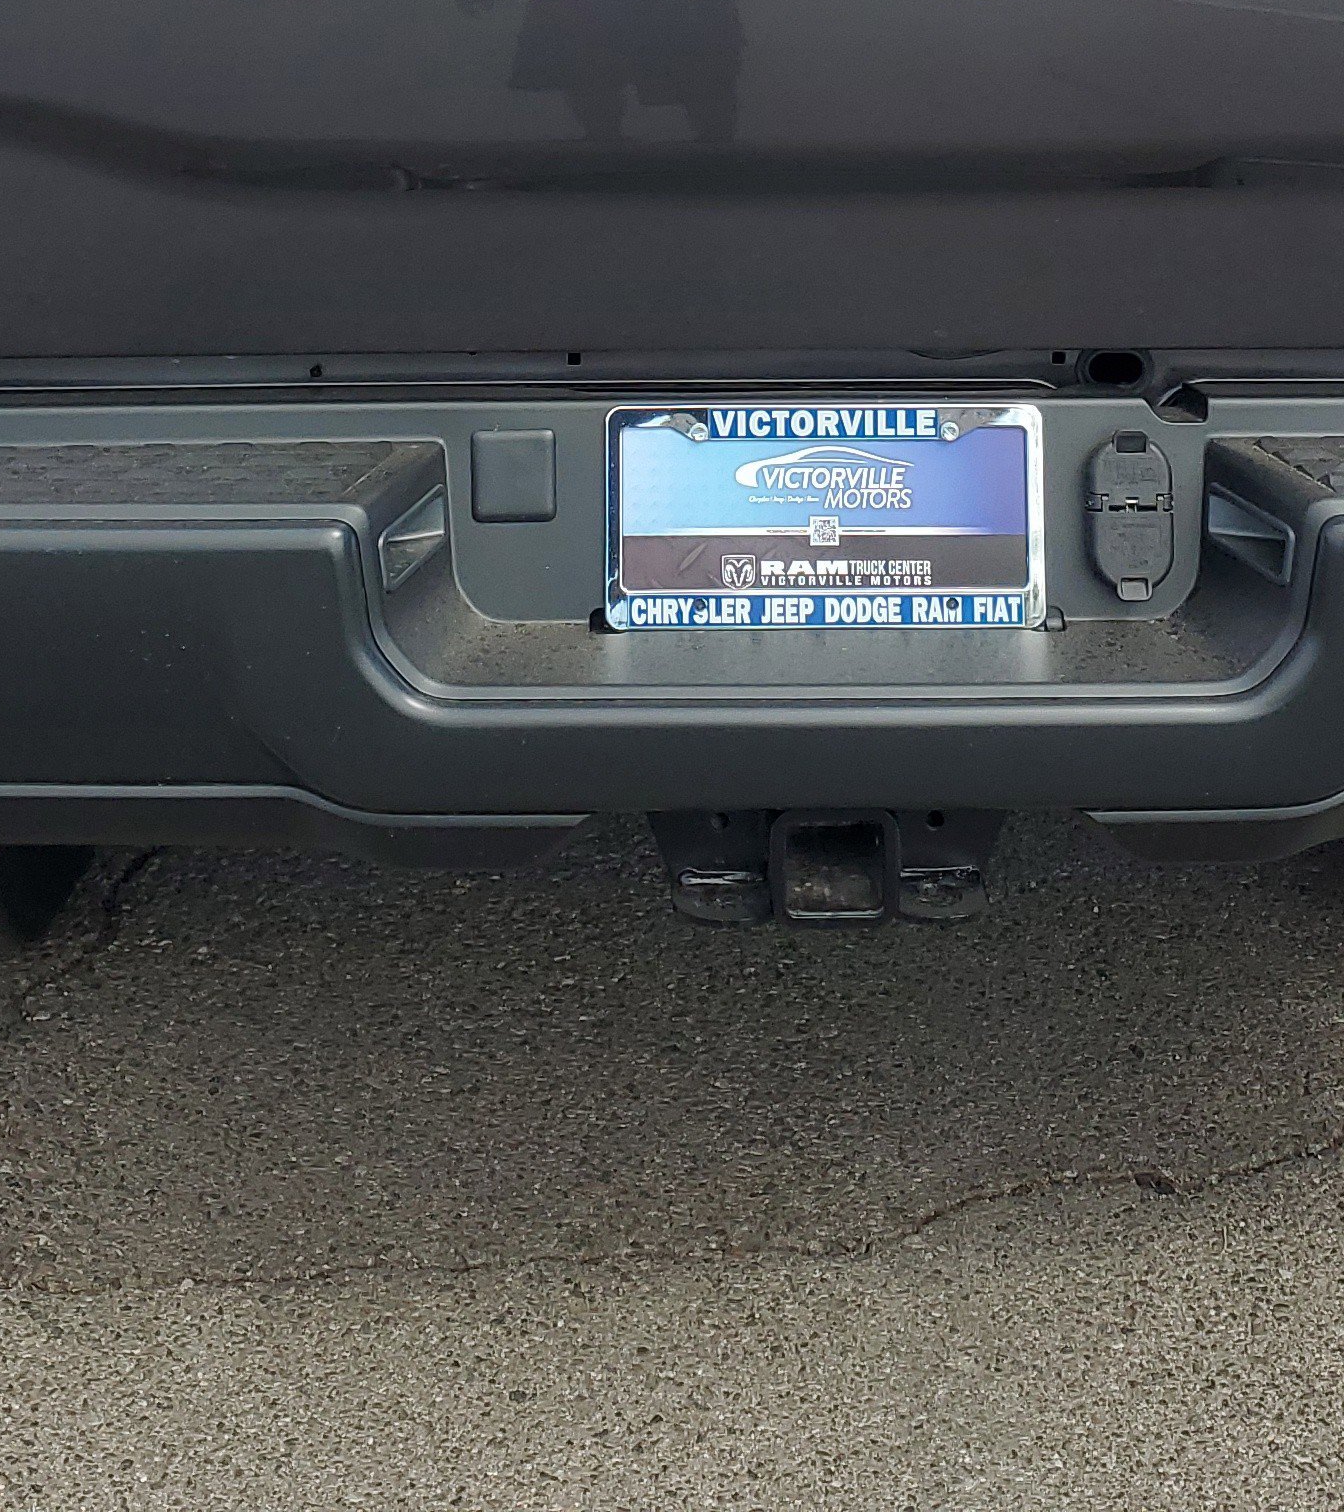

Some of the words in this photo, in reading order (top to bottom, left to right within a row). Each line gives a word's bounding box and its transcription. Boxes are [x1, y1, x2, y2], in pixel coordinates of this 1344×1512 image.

[712, 409, 936, 437] VICTORVILLE
[762, 467, 906, 489] VICTORVILLE
[823, 488, 913, 509] MOTORS
[760, 560, 848, 576] RAM
[849, 560, 886, 575] TRUCK
[888, 560, 931, 575] CENTER
[761, 575, 863, 586] VICTORVILLE
[870, 575, 932, 586] MOTORS
[631, 597, 751, 625] CHRYSLER
[761, 597, 814, 624] JEEP
[824, 596, 902, 624] DODGE
[912, 596, 963, 623] RAM
[973, 596, 1021, 623] FIAT
